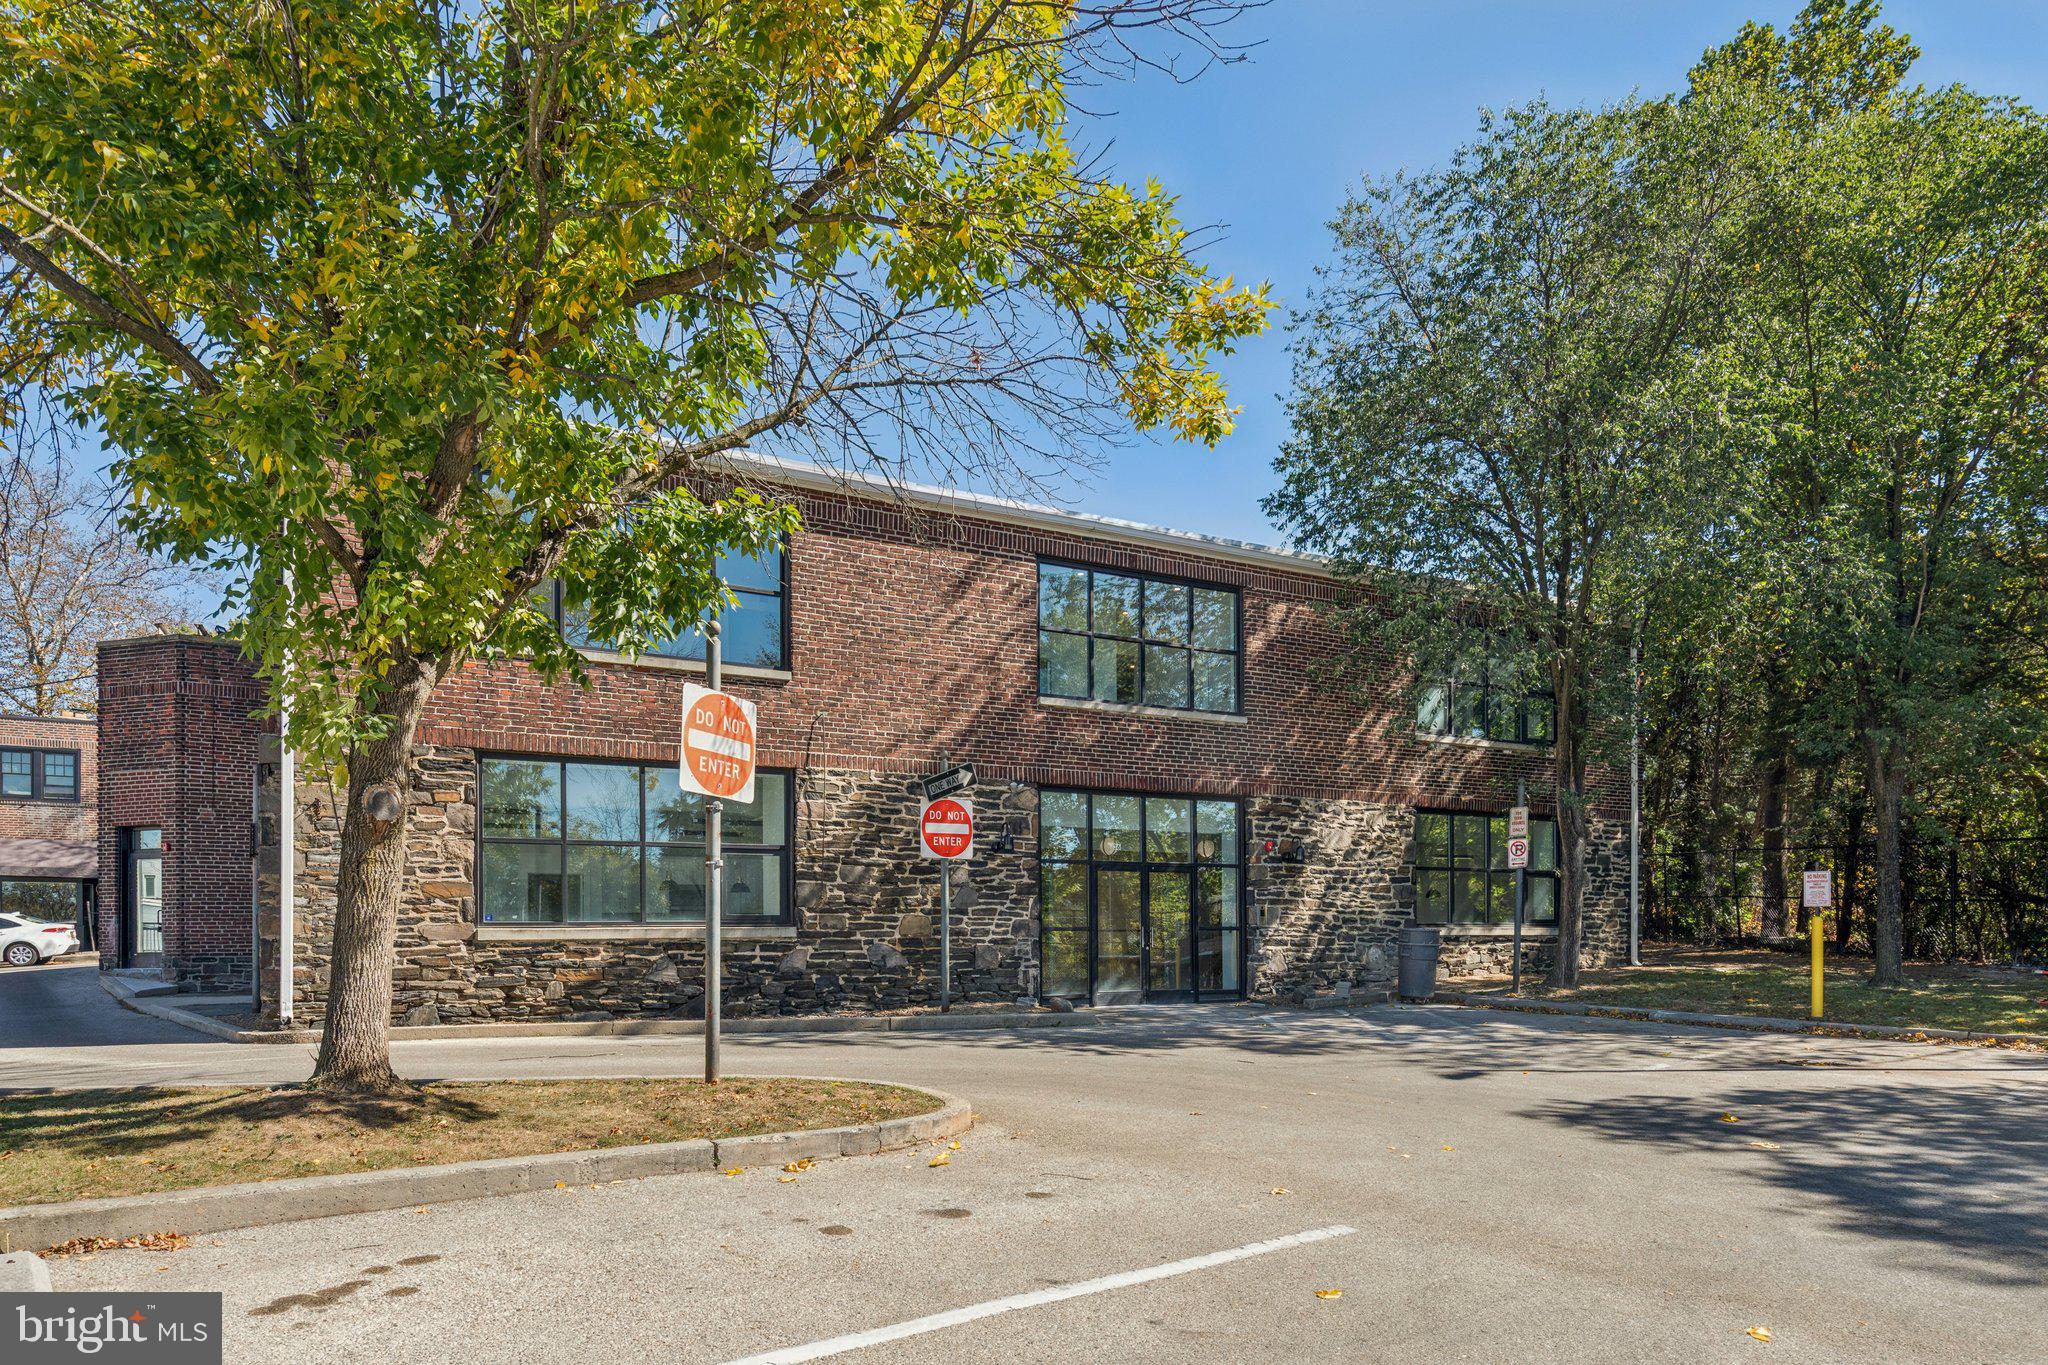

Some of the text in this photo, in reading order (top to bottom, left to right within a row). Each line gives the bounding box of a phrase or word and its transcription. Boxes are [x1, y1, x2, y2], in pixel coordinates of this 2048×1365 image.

[696, 708, 746, 735] DO NOT
[699, 755, 740, 780] ENTER
[930, 774, 960, 794] ONE WAY
[929, 810, 965, 821] DO NOT
[933, 836, 962, 847] ENTER
